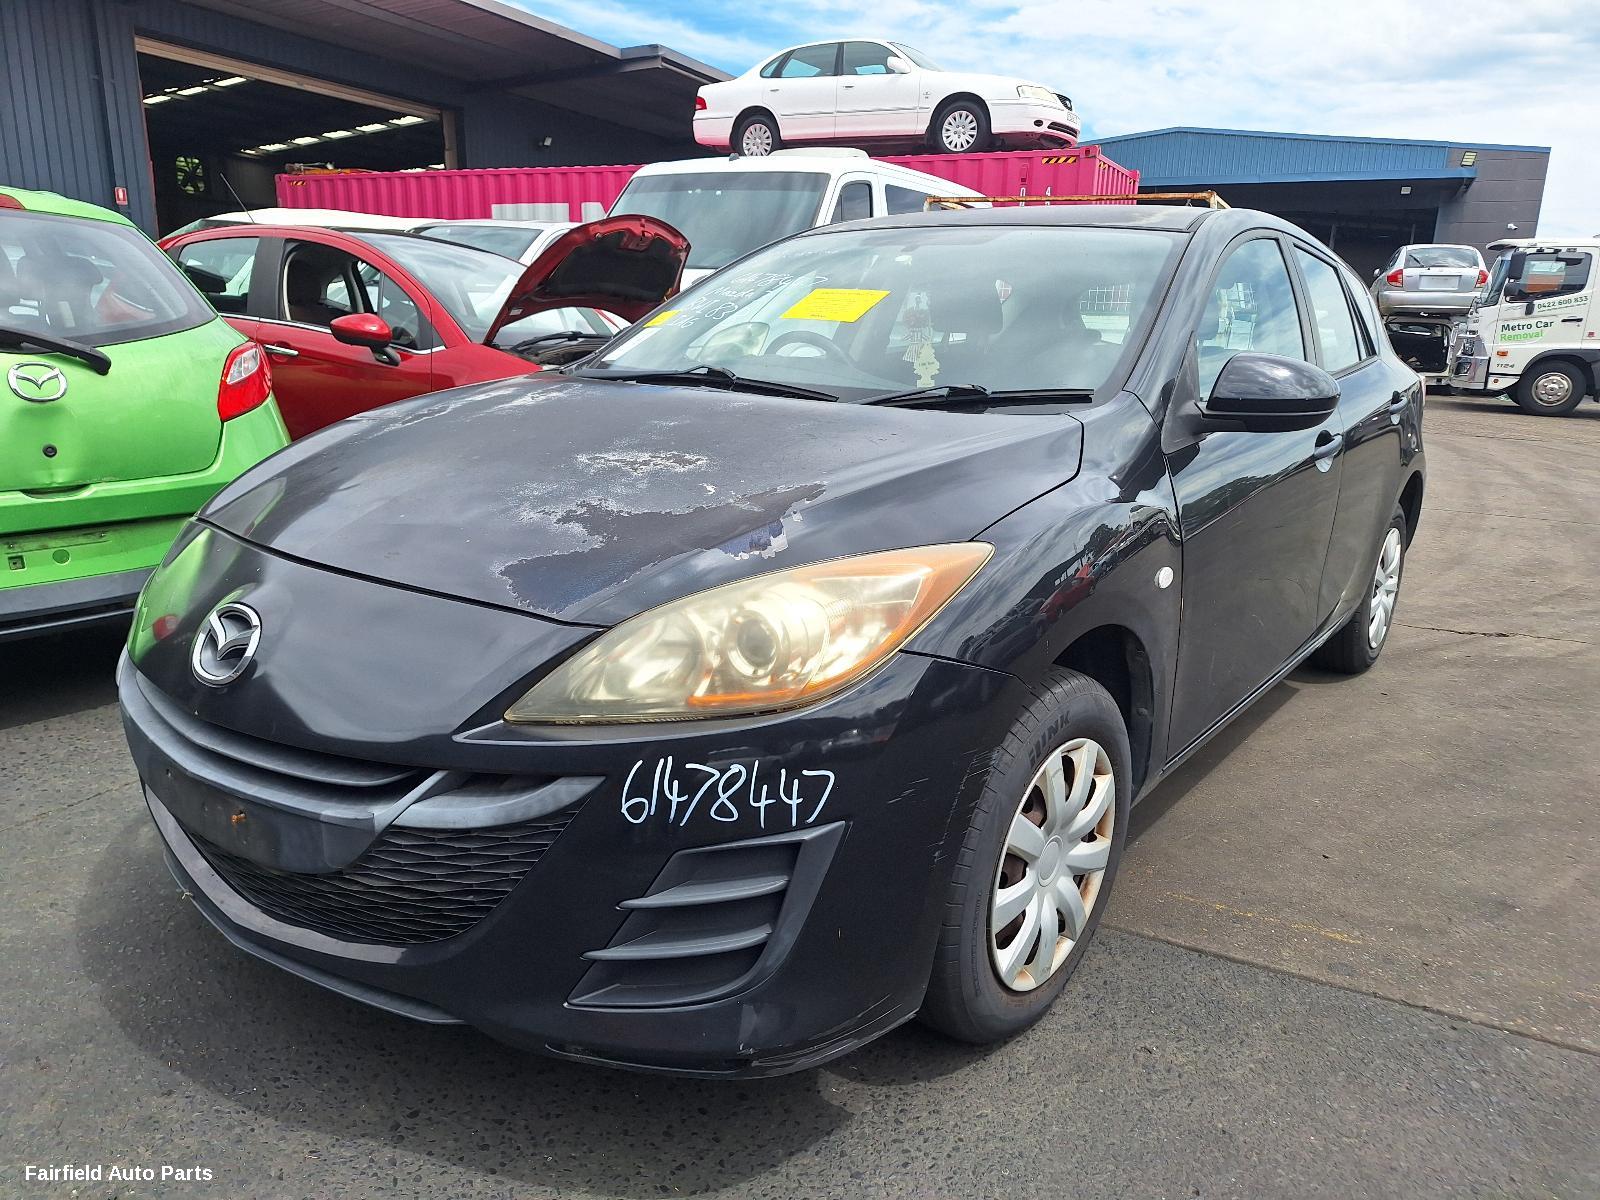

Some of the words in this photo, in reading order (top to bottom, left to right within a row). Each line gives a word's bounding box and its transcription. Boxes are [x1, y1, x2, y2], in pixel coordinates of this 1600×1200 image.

[1537, 301, 1557, 310] 0422
[1558, 298, 1572, 306] 600
[1501, 322, 1532, 333] Metro
[1535, 320, 1554, 329] Car
[1500, 329, 1543, 341] Removal
[621, 755, 836, 830] 61478447
